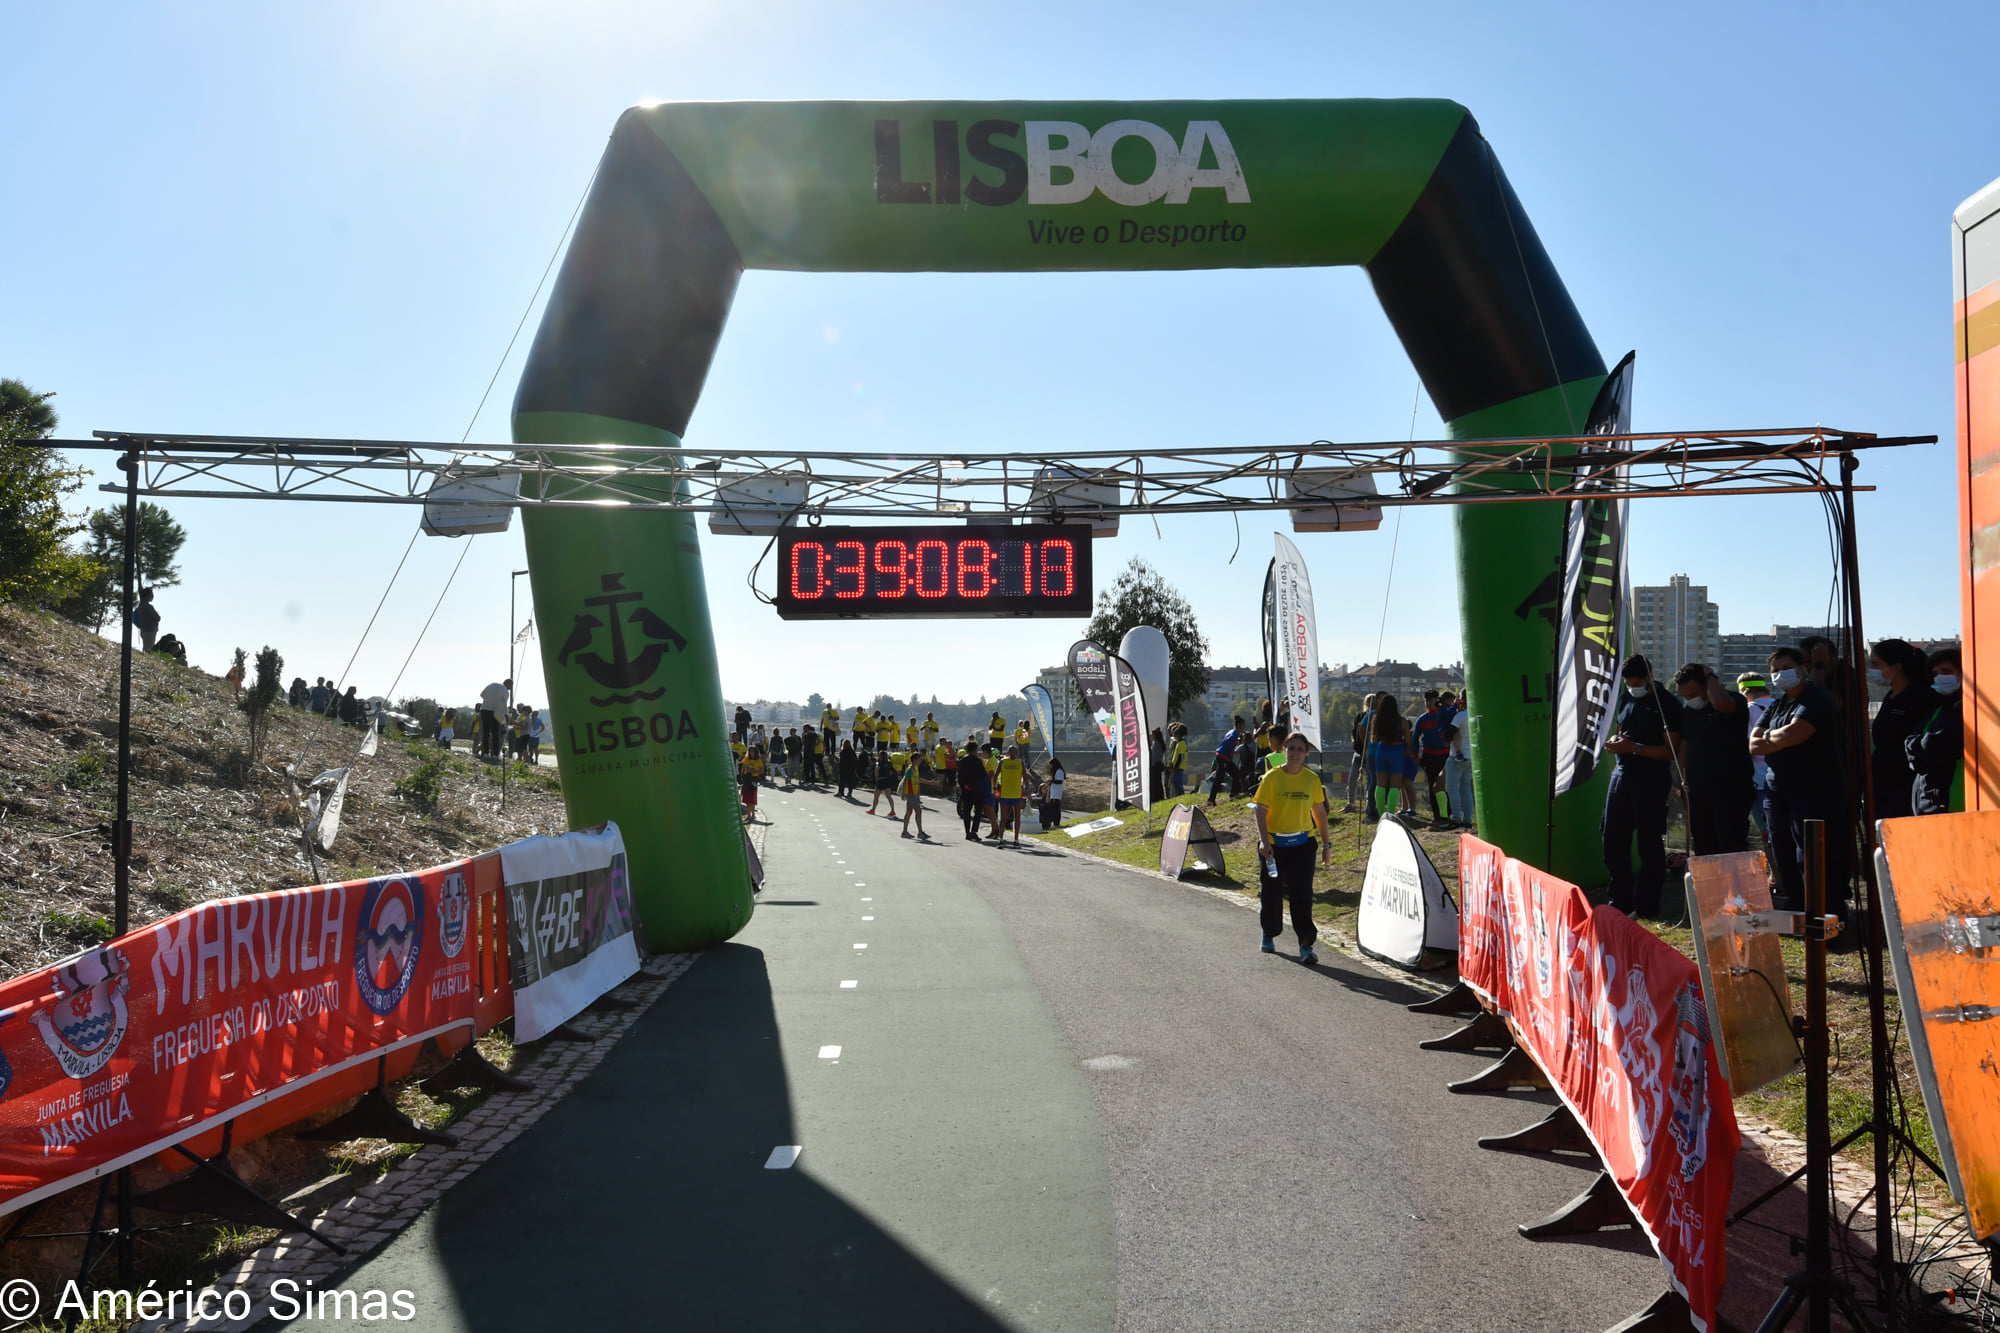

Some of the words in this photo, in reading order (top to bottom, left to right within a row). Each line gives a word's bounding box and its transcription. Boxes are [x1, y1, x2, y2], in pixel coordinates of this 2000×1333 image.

[874, 119, 1252, 207] LISBOA
[1027, 219, 1085, 245] Vive
[1093, 223, 1109, 244] o
[1118, 219, 1248, 248] Desporto
[569, 708, 700, 756] LISBOA
[629, 750, 704, 770] MUNICIPAL
[1380, 881, 1421, 922] MARVILA
[151, 883, 347, 1016] MARVILA
[356, 957, 382, 1010] FREGUESIA
[391, 945, 419, 1005] DESPORTO
[431, 973, 471, 1001] MARVILA
[58, 1043, 90, 1075] MARVILA
[97, 1026, 124, 1067] LISBOA
[152, 1005, 246, 1075] FREGUESIA
[249, 998, 273, 1036] DO
[275, 980, 340, 1027] DESPORTO
[36, 1096, 67, 1123] JUNTA
[69, 1093, 81, 1109] DE
[82, 1071, 130, 1102] FREGUESIA
[40, 1091, 133, 1157] MARVILA
